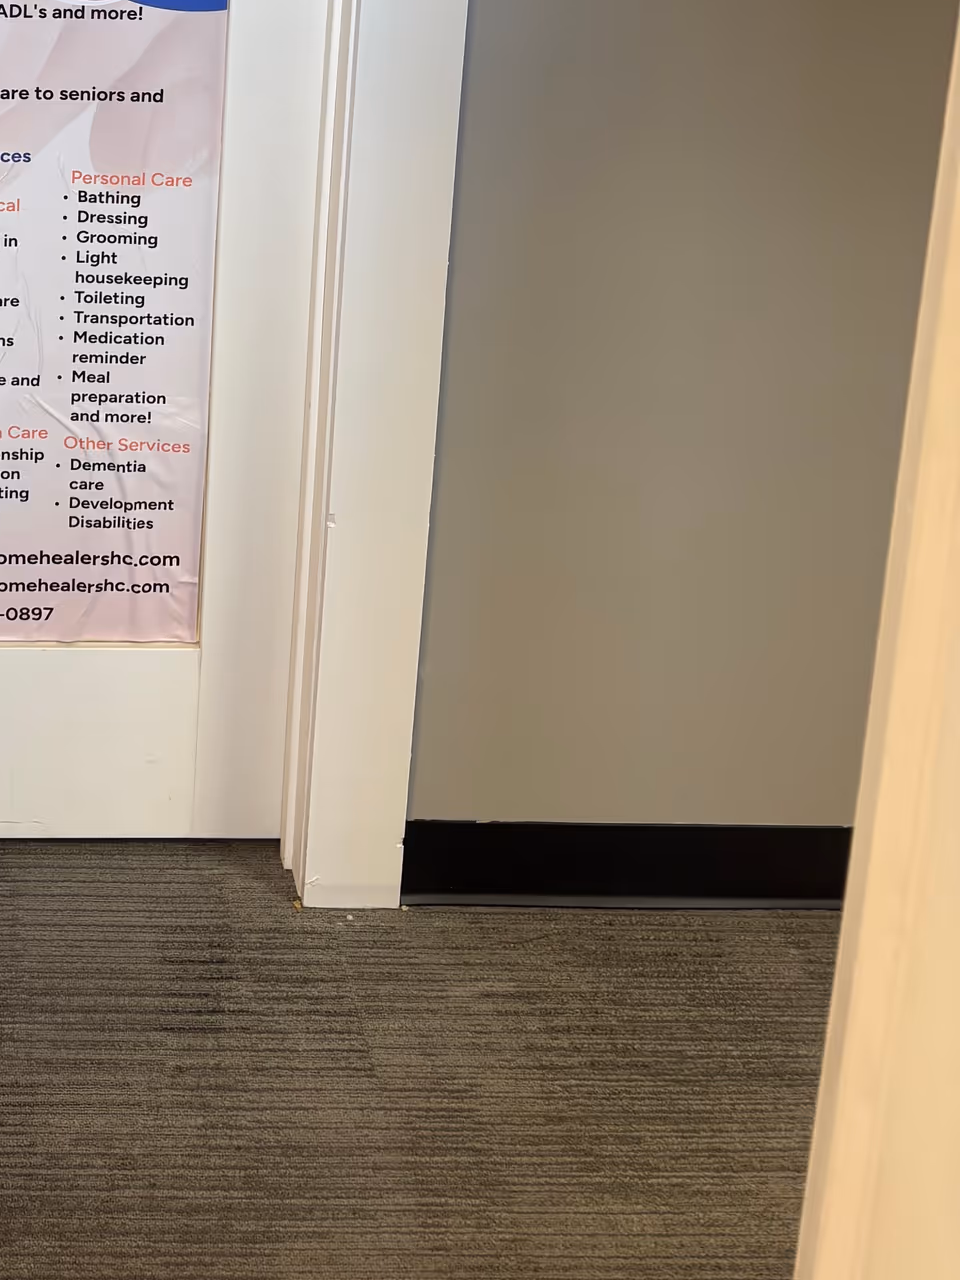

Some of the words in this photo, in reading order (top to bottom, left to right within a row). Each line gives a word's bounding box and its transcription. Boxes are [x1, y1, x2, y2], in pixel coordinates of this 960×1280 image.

[71, 170, 146, 186] Personal
[150, 172, 193, 188] Care
[78, 189, 141, 209] Bathing
[77, 209, 149, 229] Dressing
[3, 233, 18, 248] in
[76, 230, 158, 249] Grooming
[76, 250, 118, 268] Light
[75, 270, 189, 290] housekeeping
[73, 290, 145, 309] Toileting
[73, 310, 195, 328] Transportation
[73, 330, 165, 346] Medication
[72, 350, 147, 365] reminder
[10, 374, 41, 387] and
[71, 370, 110, 384] Meal
[70, 390, 166, 406] preparation
[70, 409, 100, 423] and
[104, 411, 152, 424] more!
[7, 425, 49, 440] Care
[63, 435, 114, 452] Other
[117, 437, 191, 454] Services
[70, 458, 147, 474] Dementia
[69, 480, 105, 491] care
[69, 496, 175, 514] Development
[68, 515, 154, 531] Disabilities
